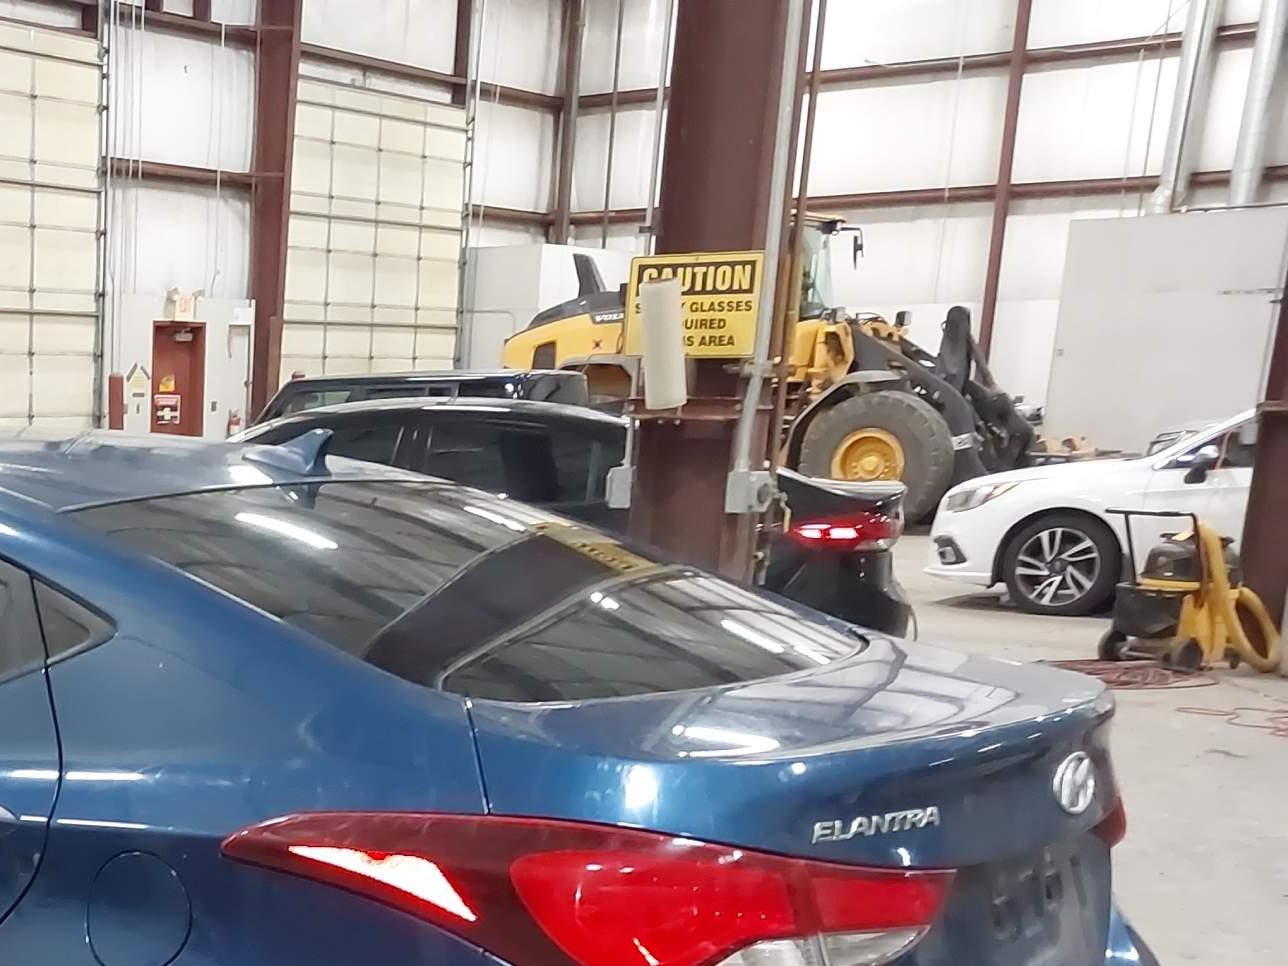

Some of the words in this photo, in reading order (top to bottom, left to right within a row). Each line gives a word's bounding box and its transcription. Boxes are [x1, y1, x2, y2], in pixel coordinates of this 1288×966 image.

[689, 300, 753, 313] GLASSES
[684, 318, 728, 330] UIRED
[698, 334, 736, 347] AREA
[811, 805, 941, 846] ELANTRA
